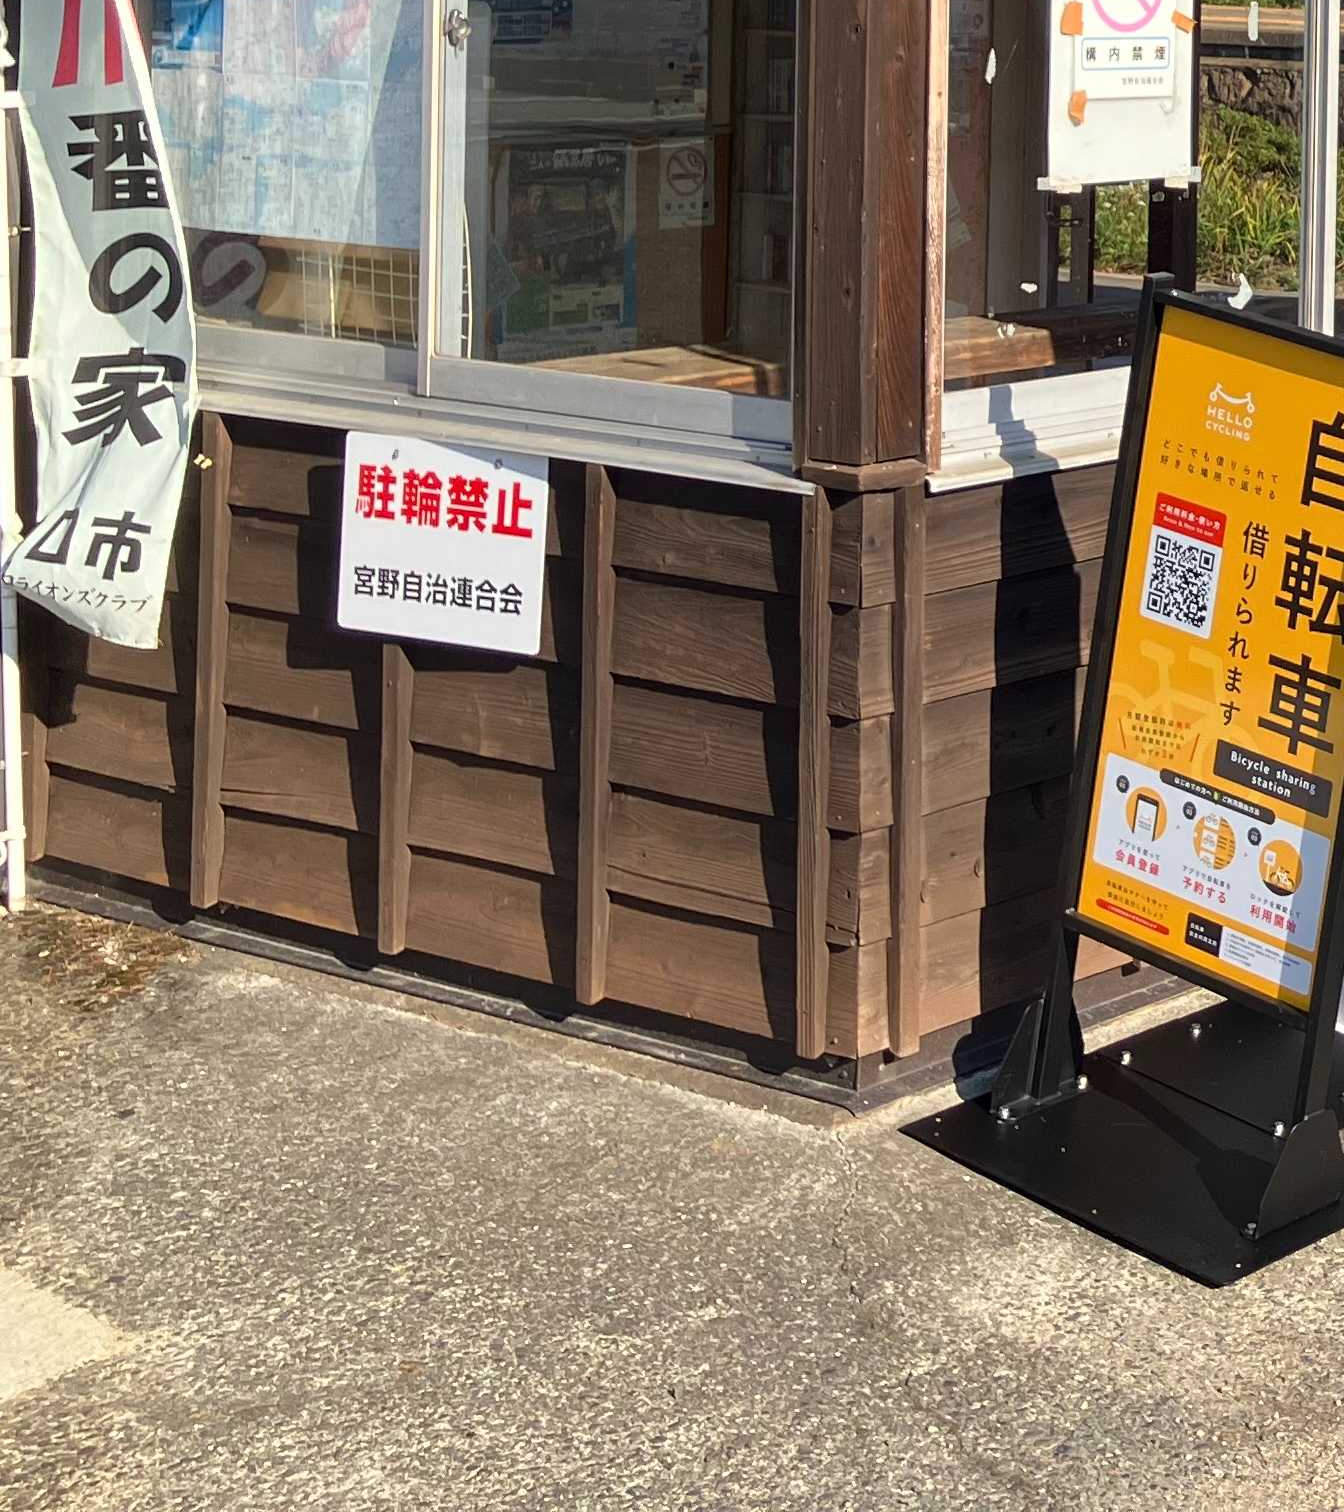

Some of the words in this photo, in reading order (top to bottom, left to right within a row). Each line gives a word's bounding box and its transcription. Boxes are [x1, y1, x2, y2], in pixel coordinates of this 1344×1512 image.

[1086, 46, 1166, 63] 構内禁煙
[1205, 420, 1251, 442] CYCLING
[1207, 405, 1253, 429] HELLO
[1163, 439, 1280, 484] どこでも借りられて
[1160, 454, 1277, 501] 好きな場所で返せる
[355, 463, 533, 538] 駐輪禁止
[353, 565, 523, 616] 宮野自治連合会
[1219, 520, 1270, 727] 借りられます
[1230, 750, 1271, 776] Bicycle
[1275, 769, 1318, 795] sharing
[1250, 775, 1292, 798] station
[1115, 849, 1160, 876] 会員登録
[1182, 876, 1227, 904] 予約する
[1250, 904, 1296, 934] 利用開始
